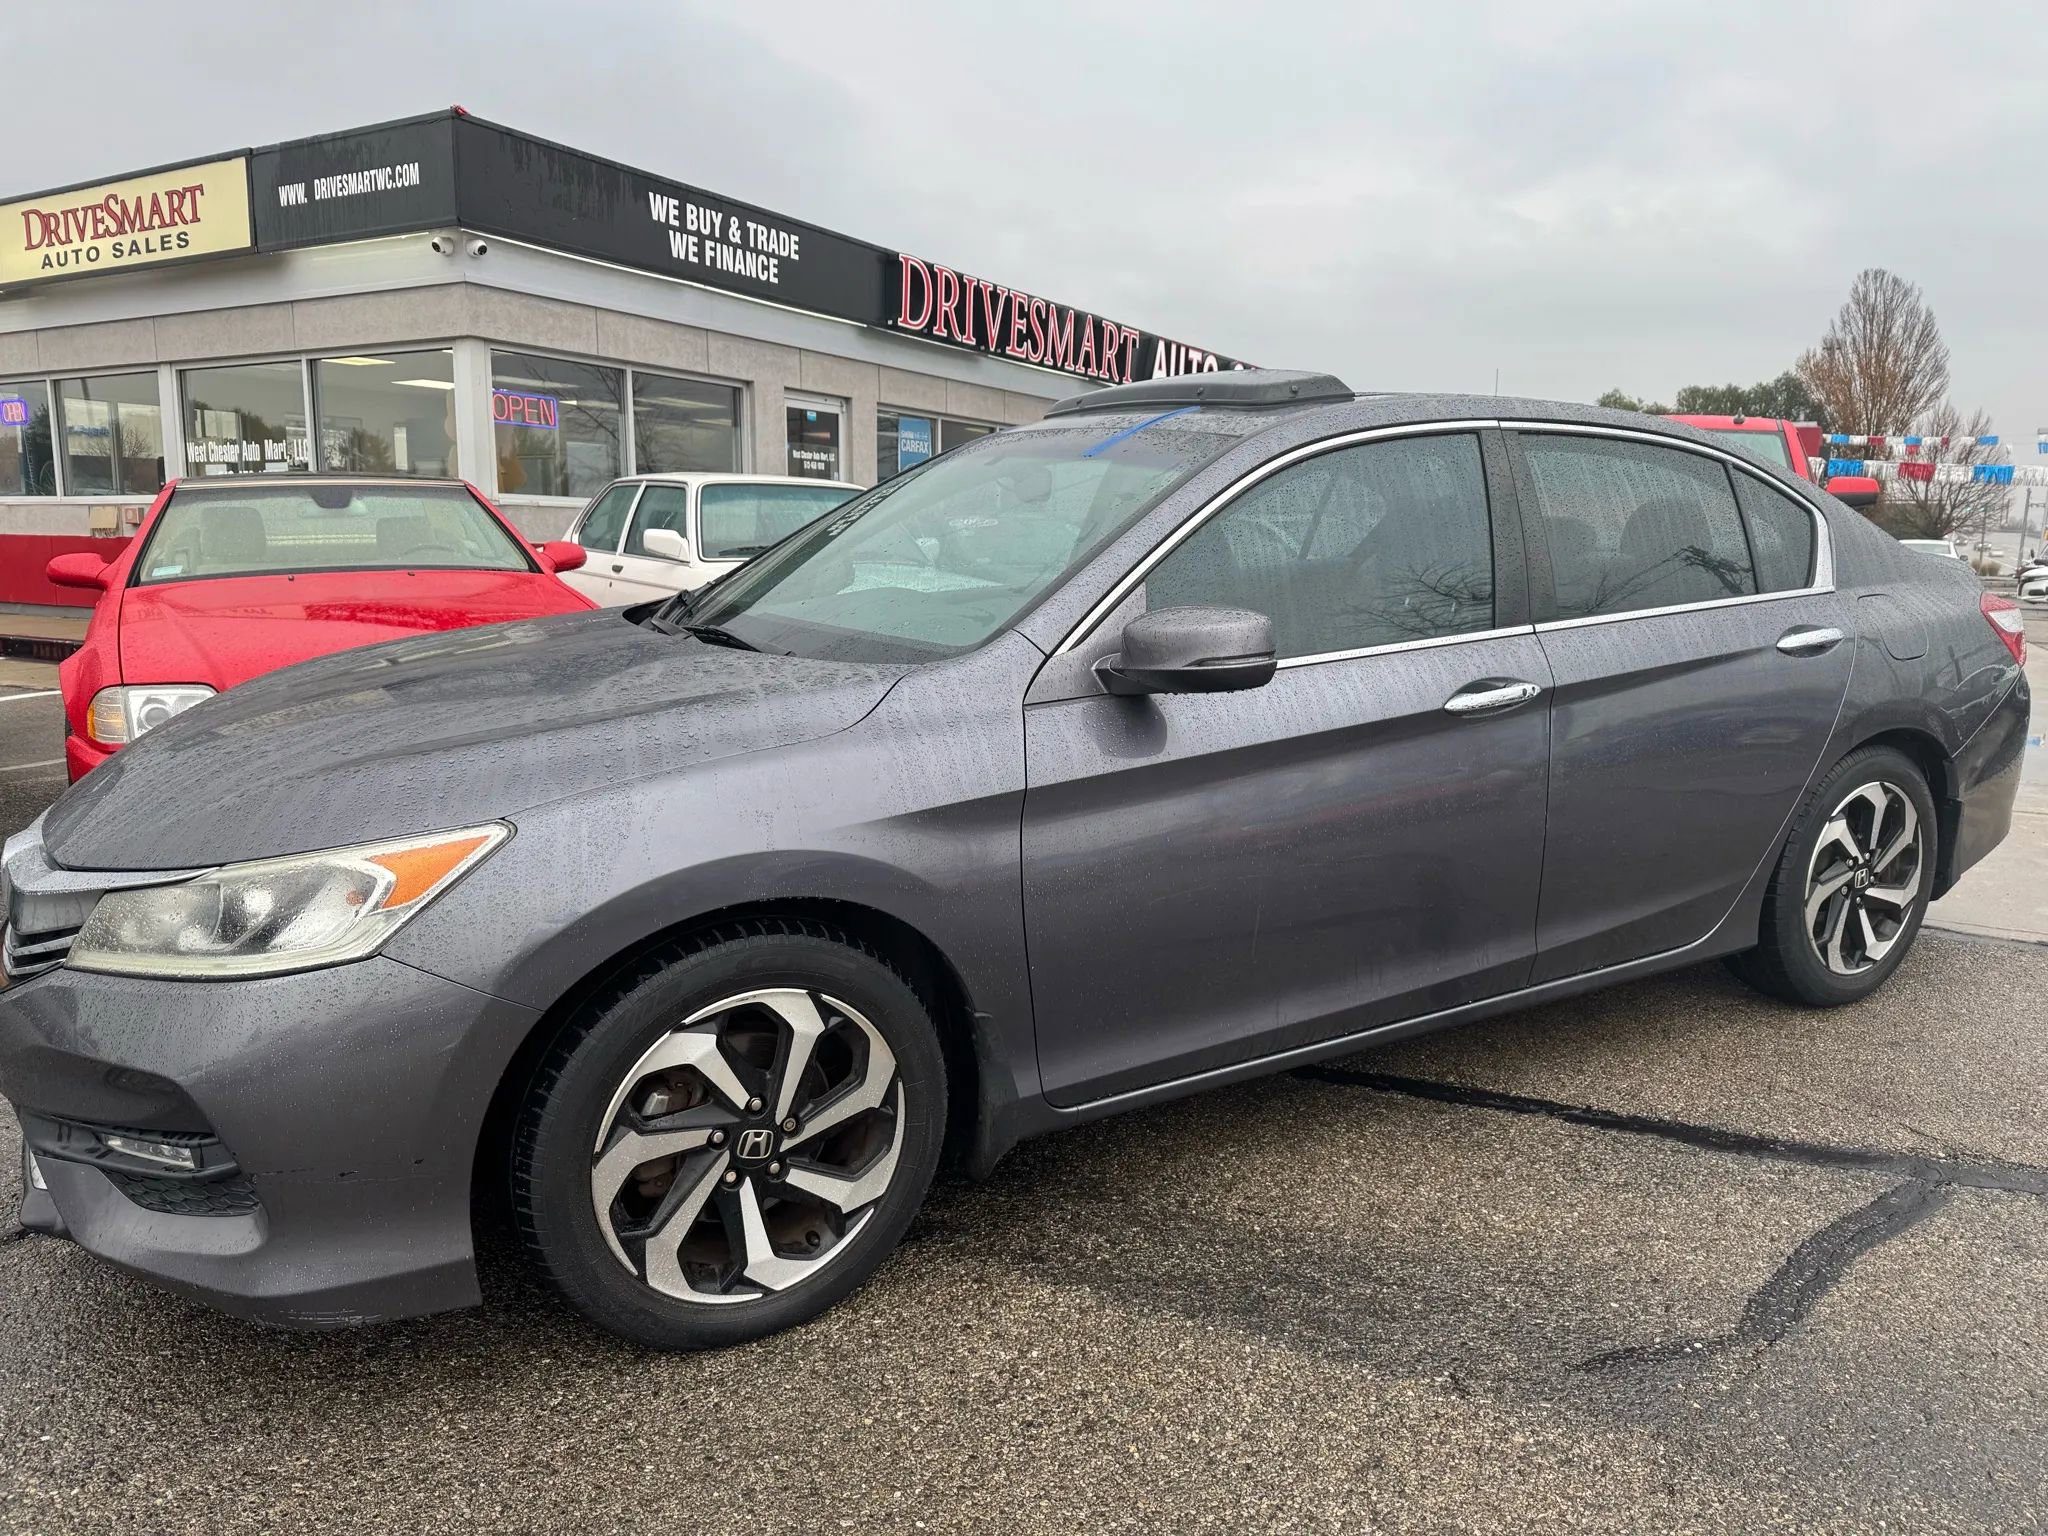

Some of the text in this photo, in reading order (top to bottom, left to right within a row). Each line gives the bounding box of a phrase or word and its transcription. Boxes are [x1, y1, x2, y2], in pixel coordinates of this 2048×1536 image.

[279, 162, 420, 208] WWW. DRIVESMARTWC.COM
[21, 184, 205, 250] DRIVESMART
[649, 192, 800, 261] WE BUY & TRADE
[41, 231, 191, 270] AUTO SALES
[669, 230, 779, 284] WE FINANCE
[898, 253, 1140, 385] DRIVESMART
[493, 394, 554, 425] OPEN
[186, 442, 207, 463] West
[208, 441, 239, 463] Chester
[242, 440, 261, 462] Auto
[264, 439, 290, 463] Mart,
[901, 439, 929, 454] CARFAX
